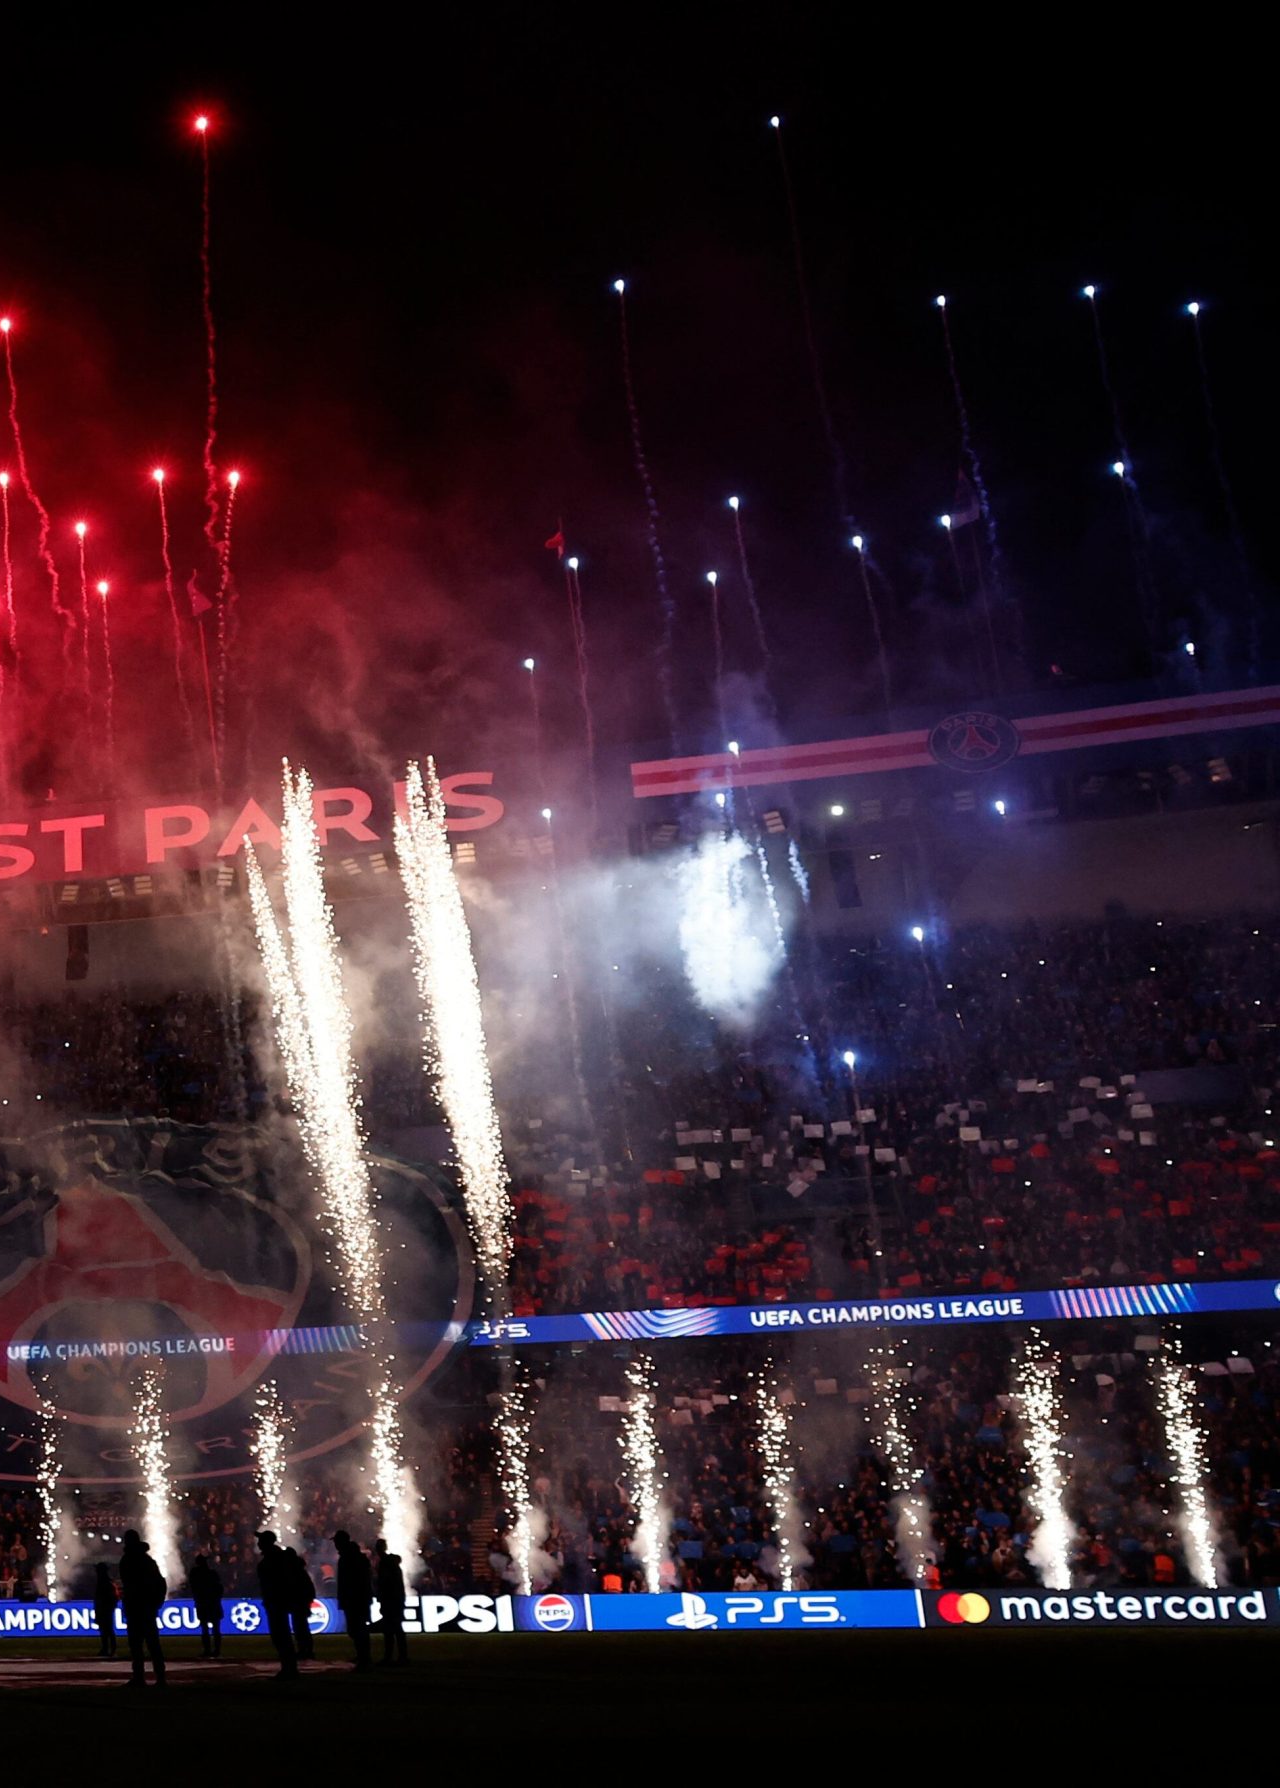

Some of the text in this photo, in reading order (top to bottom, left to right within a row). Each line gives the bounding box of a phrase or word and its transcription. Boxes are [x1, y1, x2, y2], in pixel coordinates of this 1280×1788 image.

[751, 1299, 1024, 1326] UEFA CHAMPIONS LEAGUE
[7, 1338, 234, 1359] UEFA CHAMPIONS LEAGUE
[724, 1596, 840, 1624] PS5
[1000, 1589, 1267, 1621] mastercard
